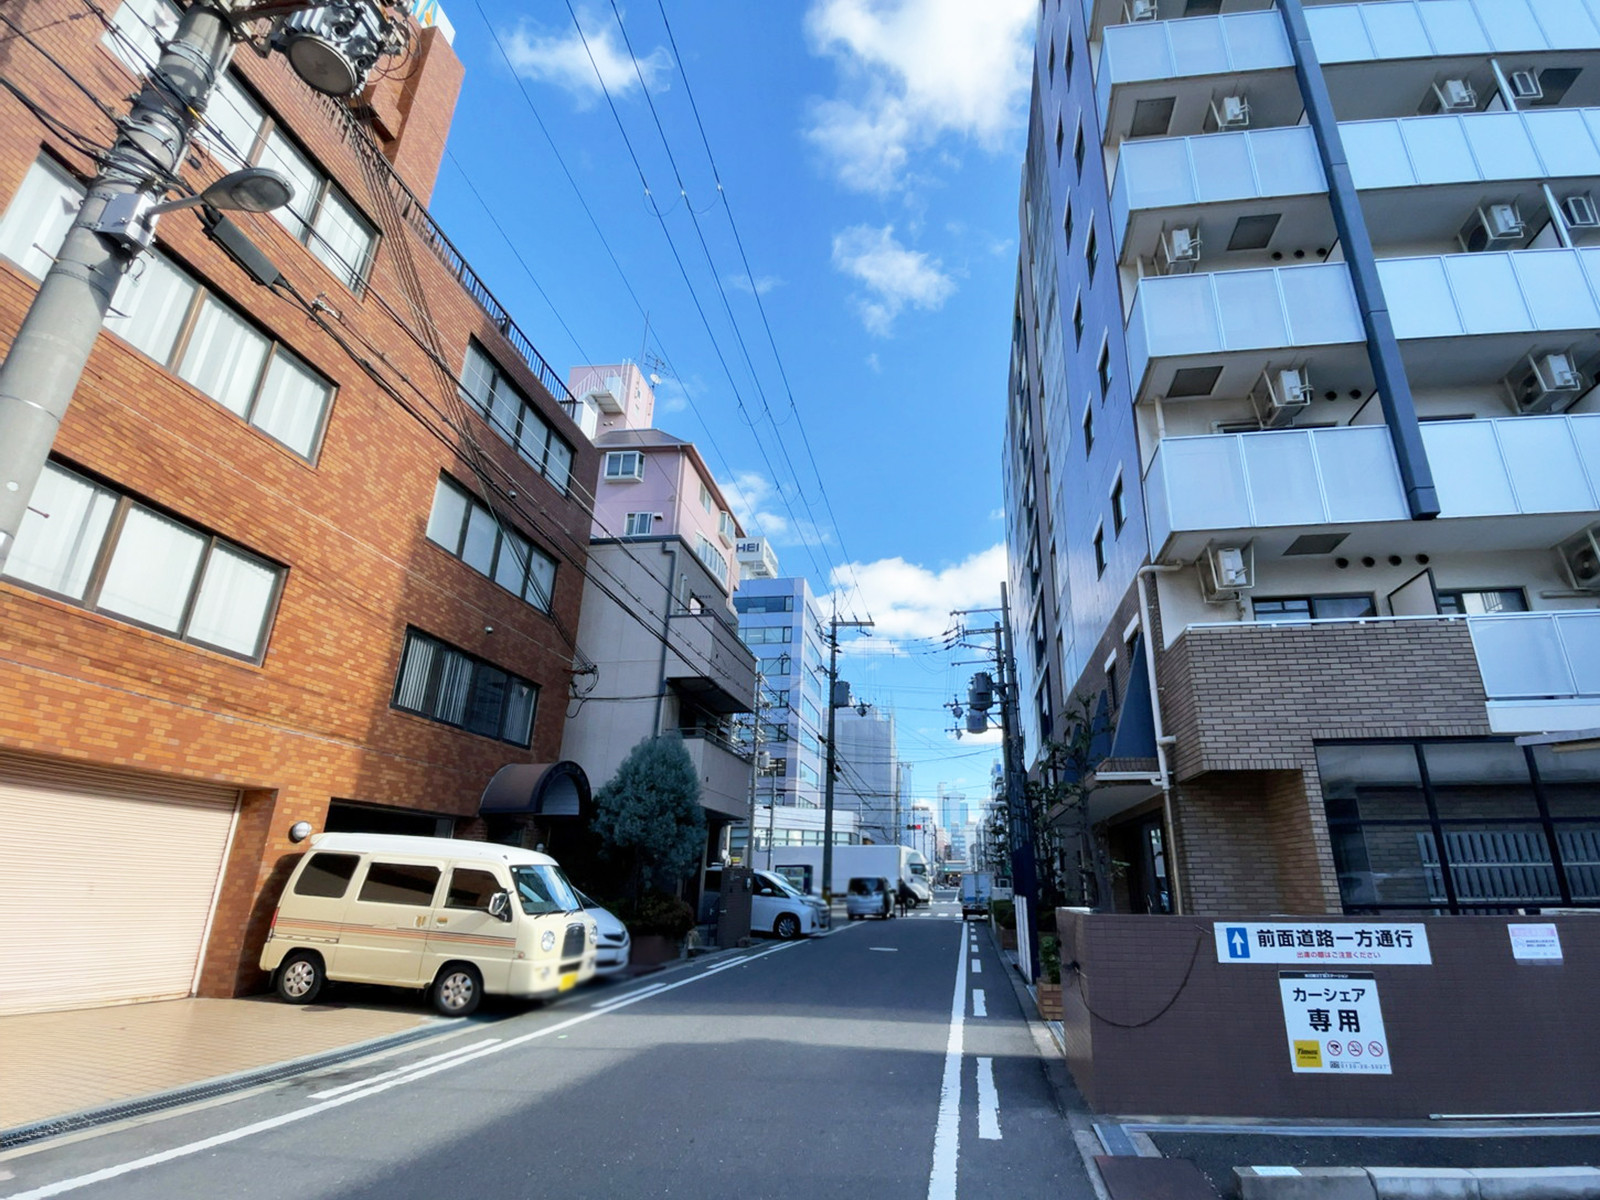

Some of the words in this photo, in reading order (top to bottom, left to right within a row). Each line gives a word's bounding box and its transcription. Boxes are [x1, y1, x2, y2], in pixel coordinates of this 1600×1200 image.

[1257, 929, 1414, 948] 前面道路一方通行
[1292, 987, 1366, 1003] カーシェア
[1307, 1008, 1361, 1033] 専用
